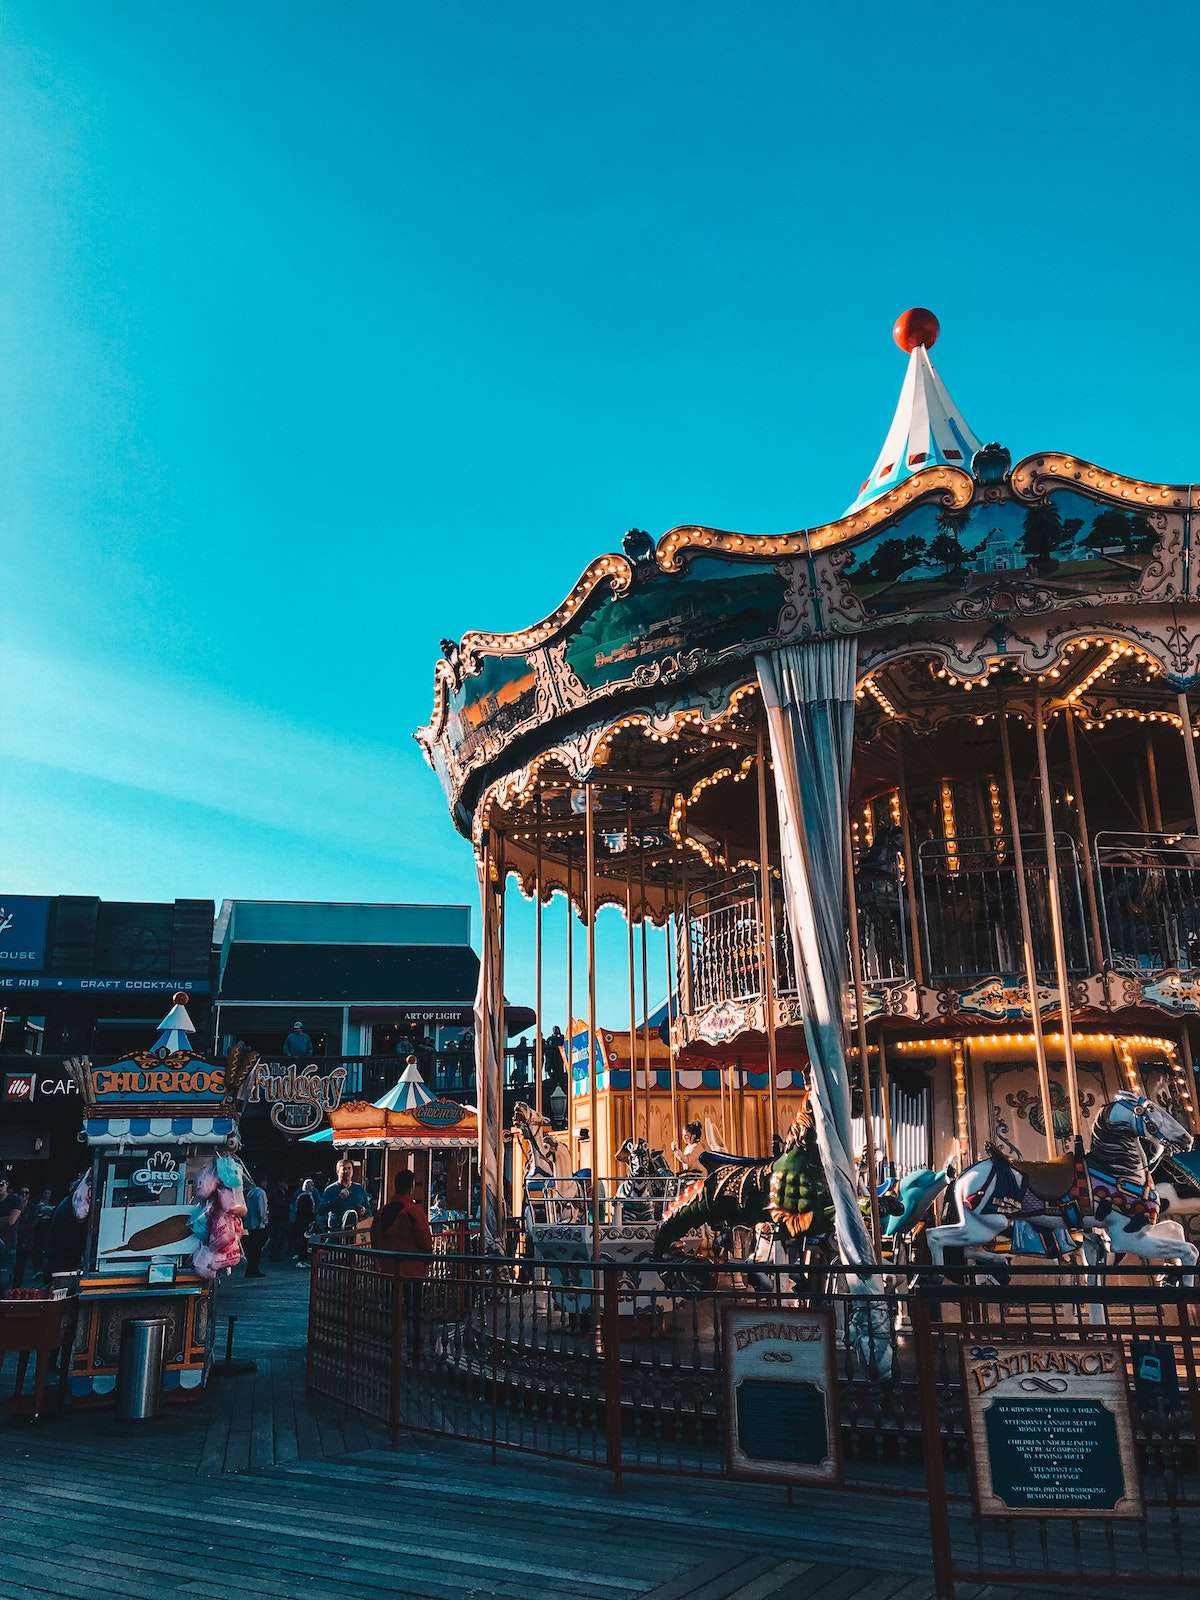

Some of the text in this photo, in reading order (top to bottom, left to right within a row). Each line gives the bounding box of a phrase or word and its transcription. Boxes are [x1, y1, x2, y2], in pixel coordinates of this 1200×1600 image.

[19, 979, 40, 987] RIB
[80, 980, 120, 988] CRAFT
[125, 981, 193, 989] COCKTAILS
[404, 1012, 461, 1020] ART OF LIGHT
[8, 1079, 30, 1097] illy
[40, 1079, 79, 1095] CAF
[92, 1070, 226, 1094] CHURROS
[248, 1064, 347, 1112] Fudgery
[135, 1170, 179, 1182] OREO
[734, 1322, 821, 1351] ENTRANCE
[972, 1351, 1117, 1395] ENTRANCE
